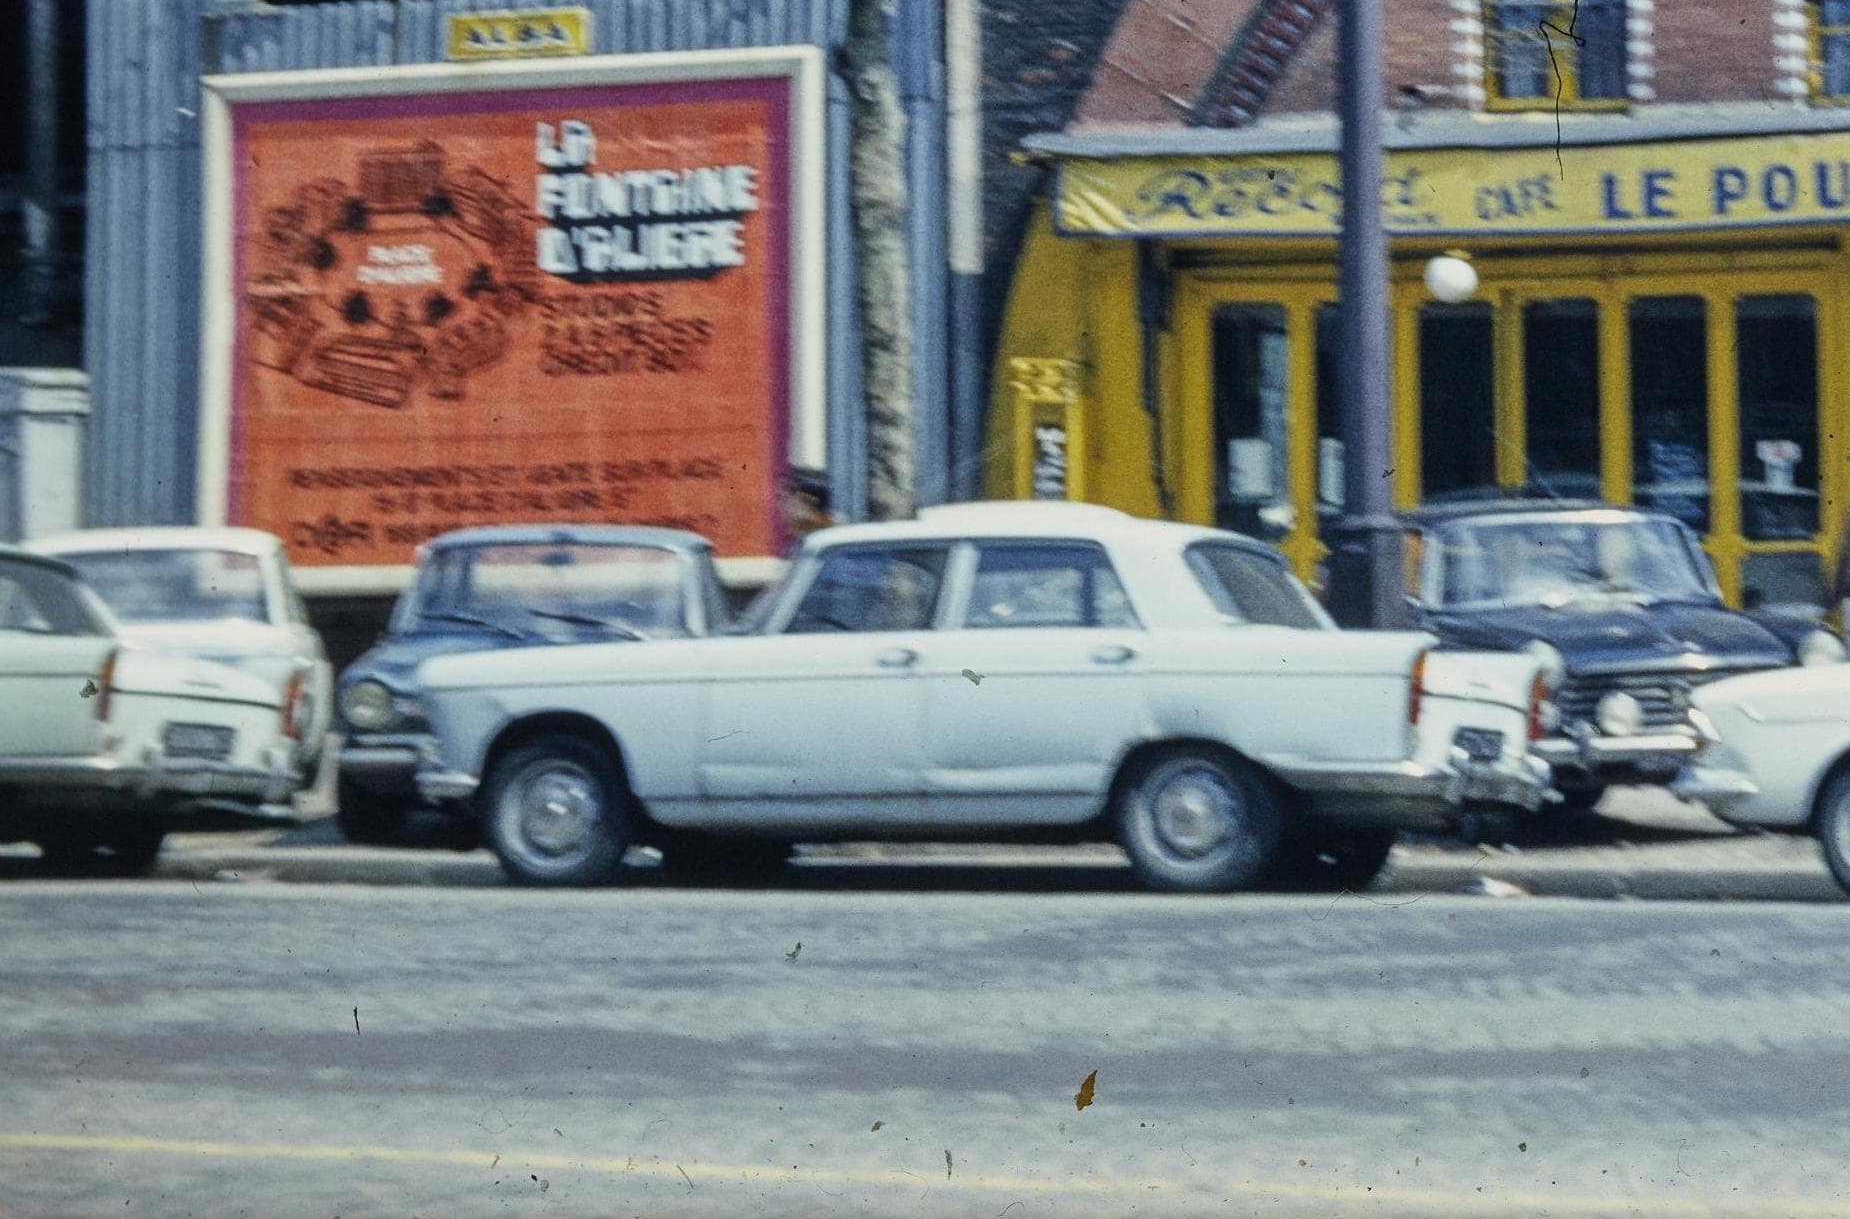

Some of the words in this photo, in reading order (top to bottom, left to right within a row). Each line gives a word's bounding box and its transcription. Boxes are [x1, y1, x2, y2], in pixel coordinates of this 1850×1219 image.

[535, 120, 597, 167] LA
[1122, 167, 1424, 221] Recod
[1601, 166, 1679, 221] LE
